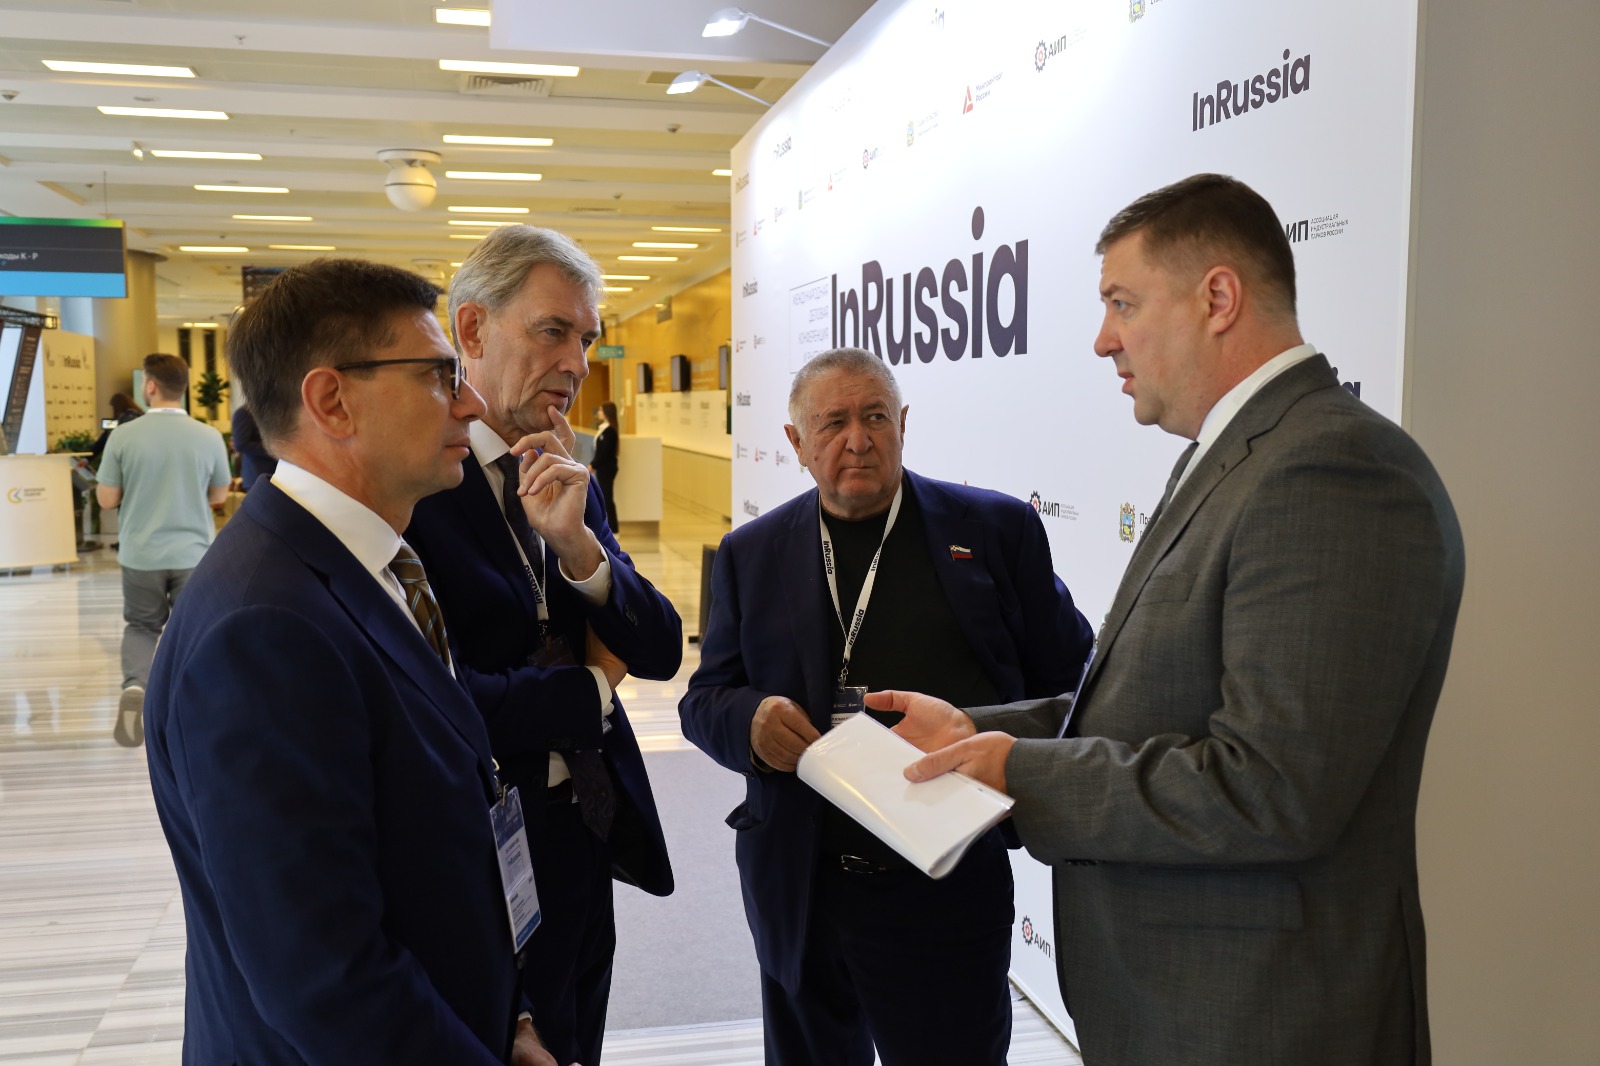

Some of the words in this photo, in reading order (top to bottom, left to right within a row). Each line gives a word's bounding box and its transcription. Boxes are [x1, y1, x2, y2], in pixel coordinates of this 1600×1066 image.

[1047, 35, 1067, 59] АИП
[1191, 48, 1311, 132] InRussia
[1286, 220, 1308, 243] ИП
[831, 206, 1029, 366] InRussia
[1042, 501, 1060, 518] АИП
[823, 540, 834, 575] InRussia
[849, 609, 865, 646] InRussia
[1034, 932, 1051, 958] АИП
